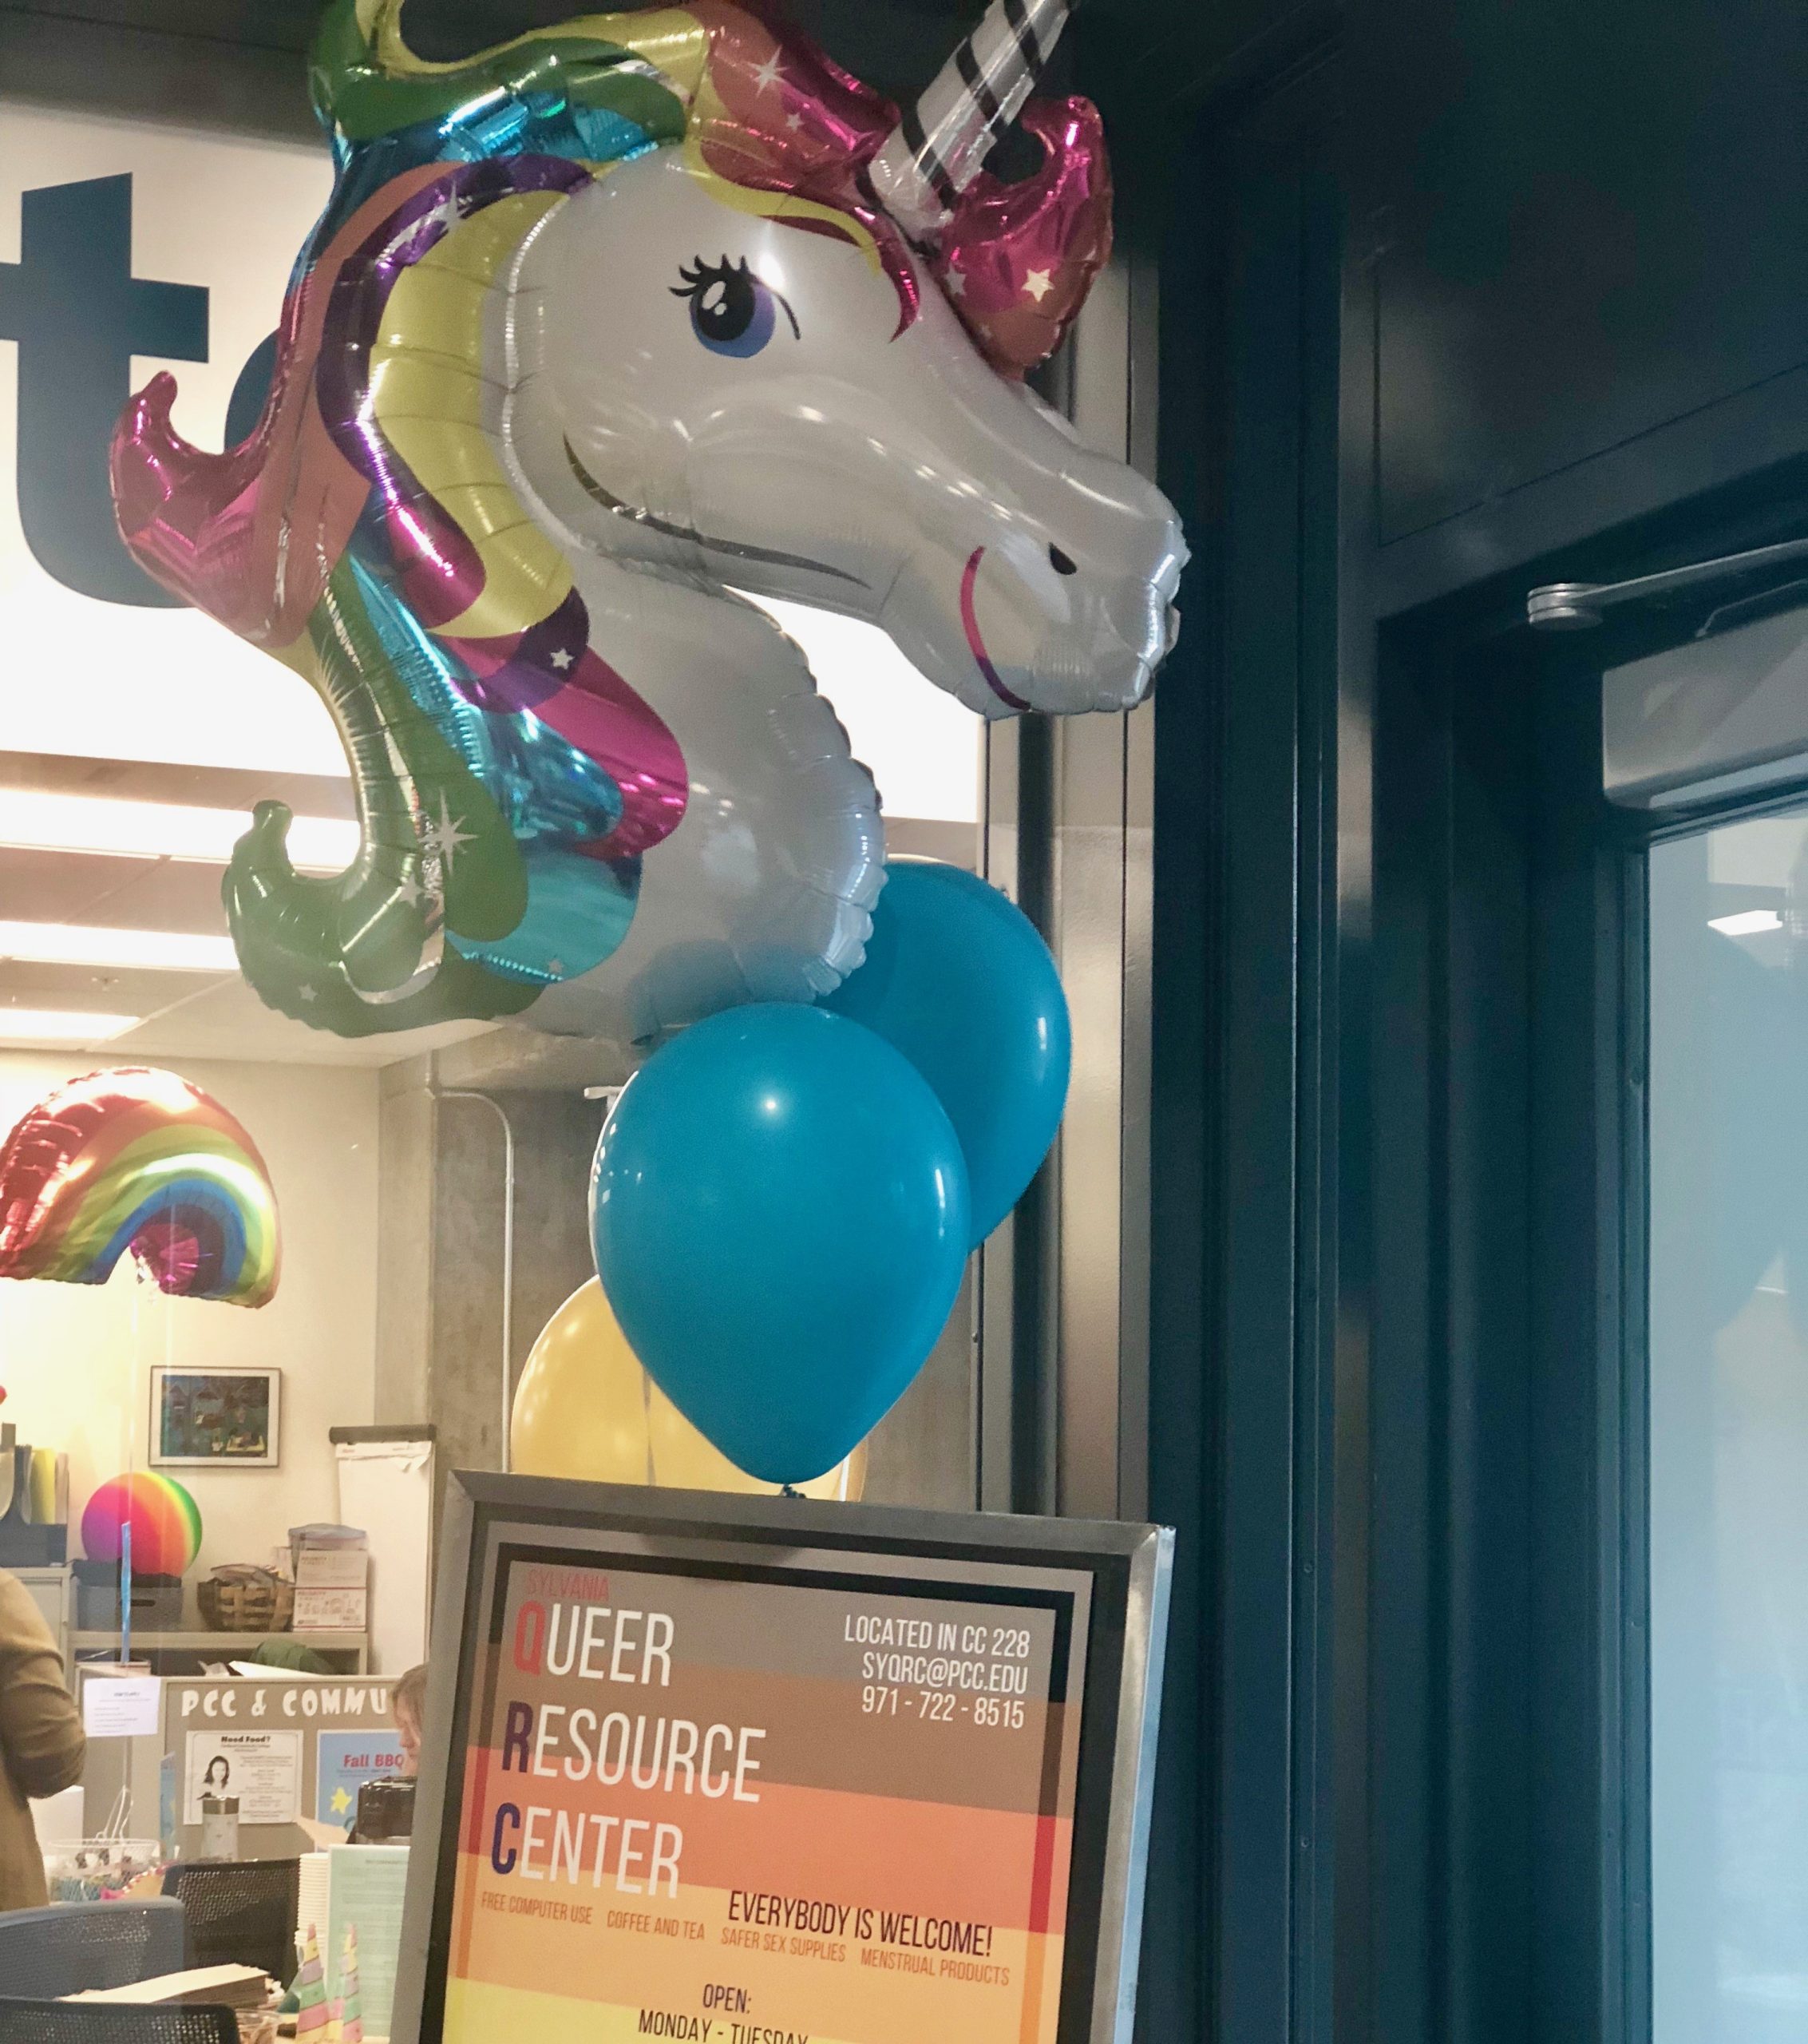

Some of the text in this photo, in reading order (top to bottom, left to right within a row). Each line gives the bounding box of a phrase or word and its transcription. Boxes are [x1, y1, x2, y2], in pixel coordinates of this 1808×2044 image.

[527, 1569, 609, 1601] SYLVANIA
[513, 1601, 675, 1686] QUEER
[845, 1614, 1031, 1658] LOCATED IN CC 228
[862, 1651, 1028, 1694] SYQRC@PCC.EDU
[181, 1687, 387, 1717] PCC & COMMU
[862, 1686, 899, 1716] 971
[919, 1690, 956, 1721] 722
[974, 1697, 1025, 1729] 8515
[343, 1754, 404, 1769] Fall BBQ
[502, 1701, 767, 1803] RESOURCE
[492, 1802, 683, 1899] CENTER
[481, 1891, 1010, 1986] FREE COMPUTER USE COFFEE AND TEA SAFER SEX SUPPLIES MENSTRUAL PRODUCTS
[729, 1890, 992, 1956] EVERYBODY IS WELCOME!
[702, 1983, 752, 2014] OPEN:
[639, 2009, 713, 2043] MONDAY
